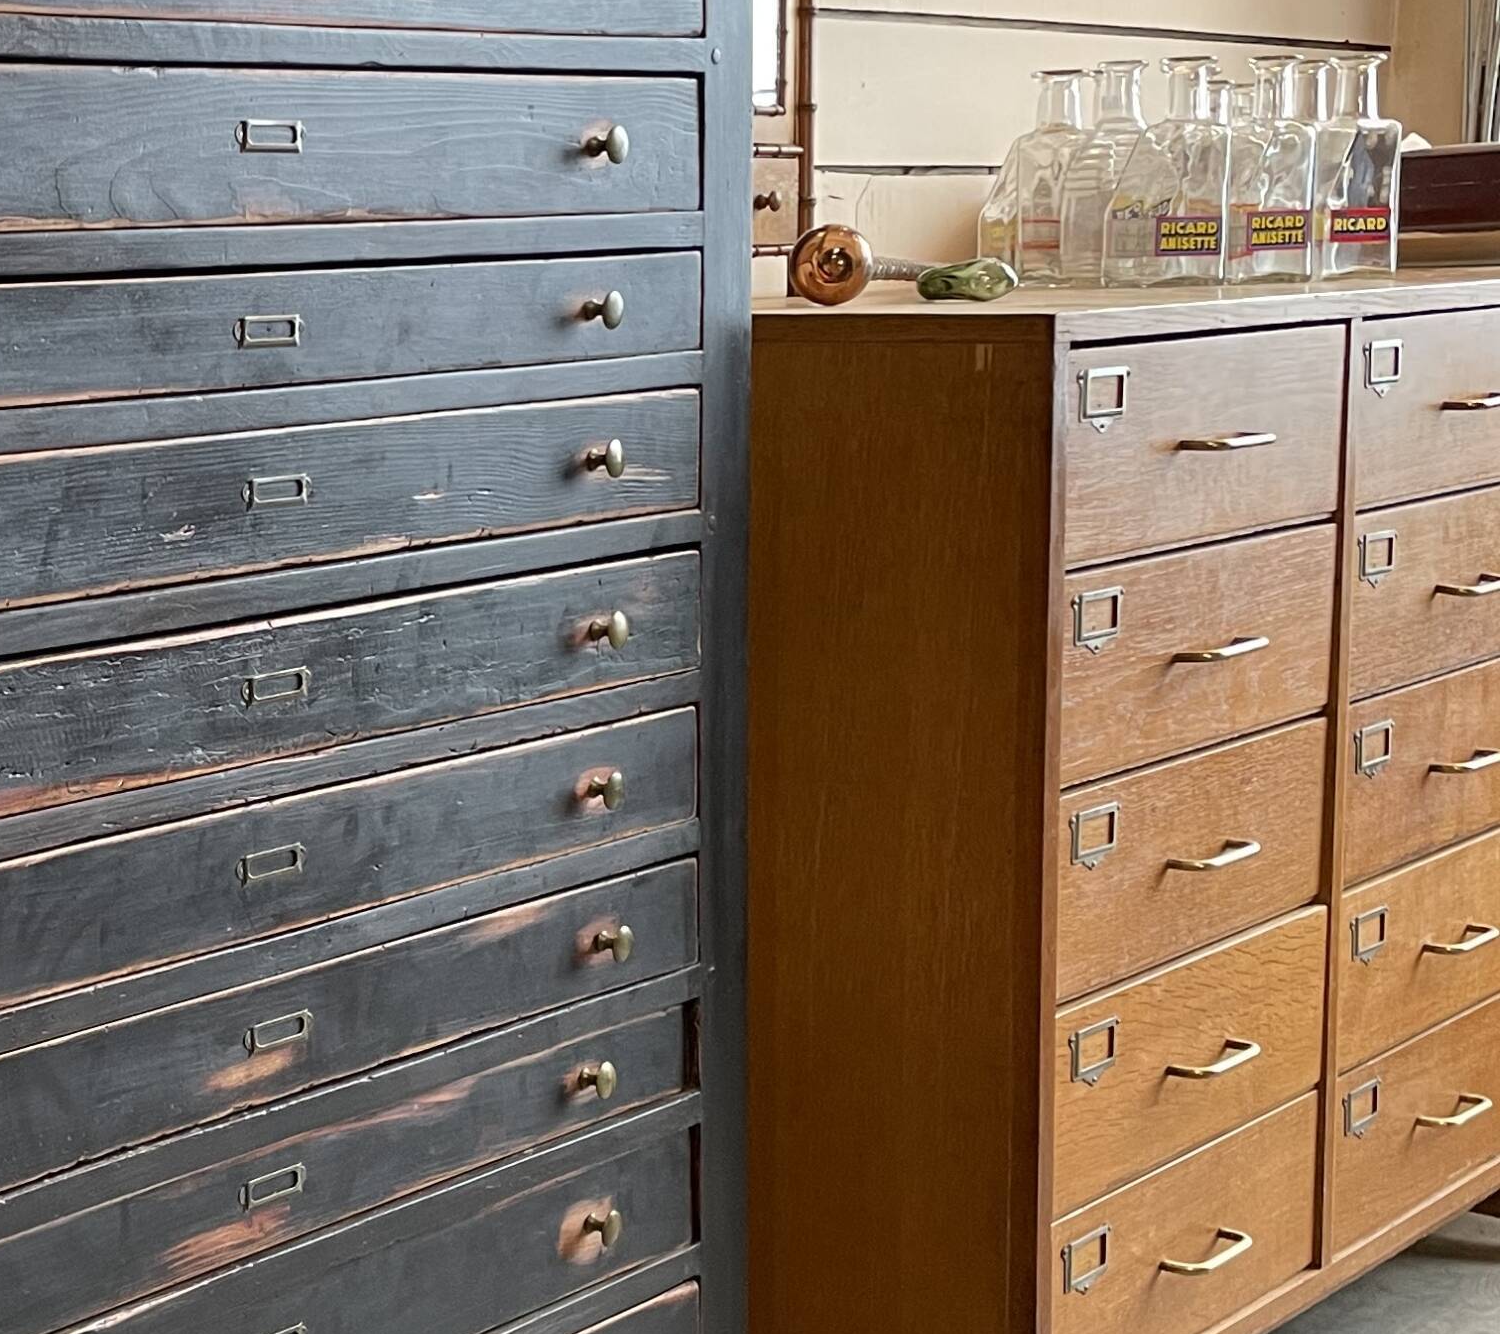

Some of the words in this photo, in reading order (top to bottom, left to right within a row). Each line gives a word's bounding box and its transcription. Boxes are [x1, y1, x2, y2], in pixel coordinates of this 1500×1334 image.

[1160, 221, 1218, 235] RICARD
[1251, 214, 1305, 230] RICARD
[1333, 217, 1387, 233] RICARD
[1160, 236, 1217, 251] ANISETTE
[1251, 230, 1304, 245] ANISETTE
